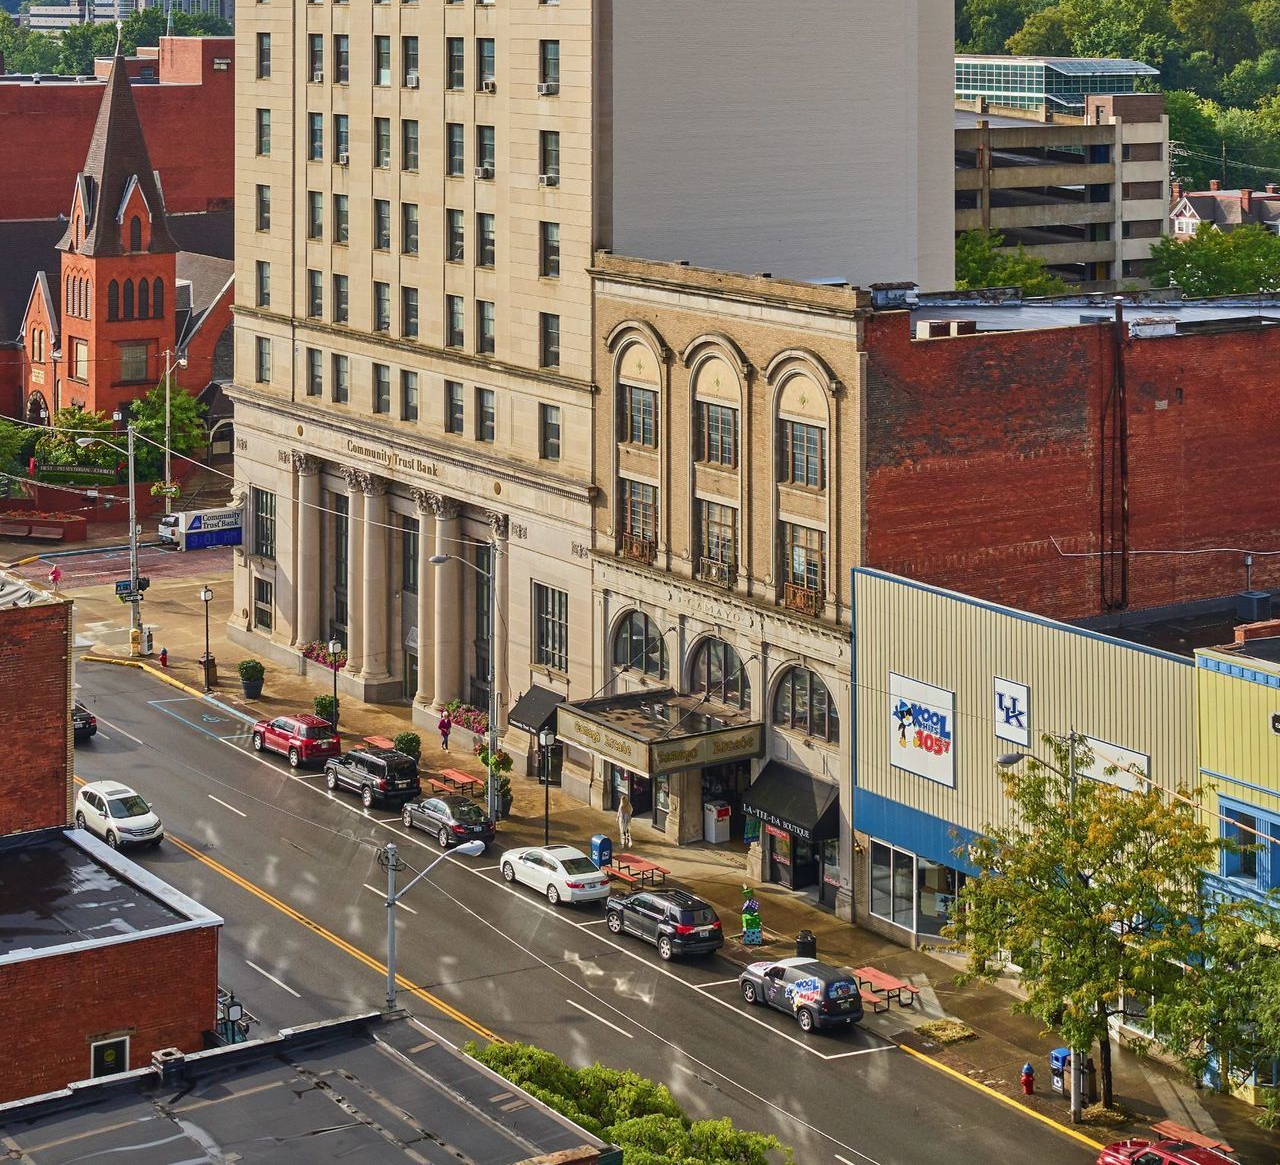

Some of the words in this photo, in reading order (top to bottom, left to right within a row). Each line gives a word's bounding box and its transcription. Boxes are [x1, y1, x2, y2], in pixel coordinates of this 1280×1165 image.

[347, 439, 393, 466] Community
[393, 453, 415, 470] Trust
[417, 459, 439, 477] Bank
[202, 511, 241, 522] Community
[202, 520, 220, 530] Trust
[221, 519, 239, 527] Bank
[910, 701, 951, 740] KOOL
[996, 691, 1027, 731] UK
[782, 820, 810, 839] BOUTIQUE
